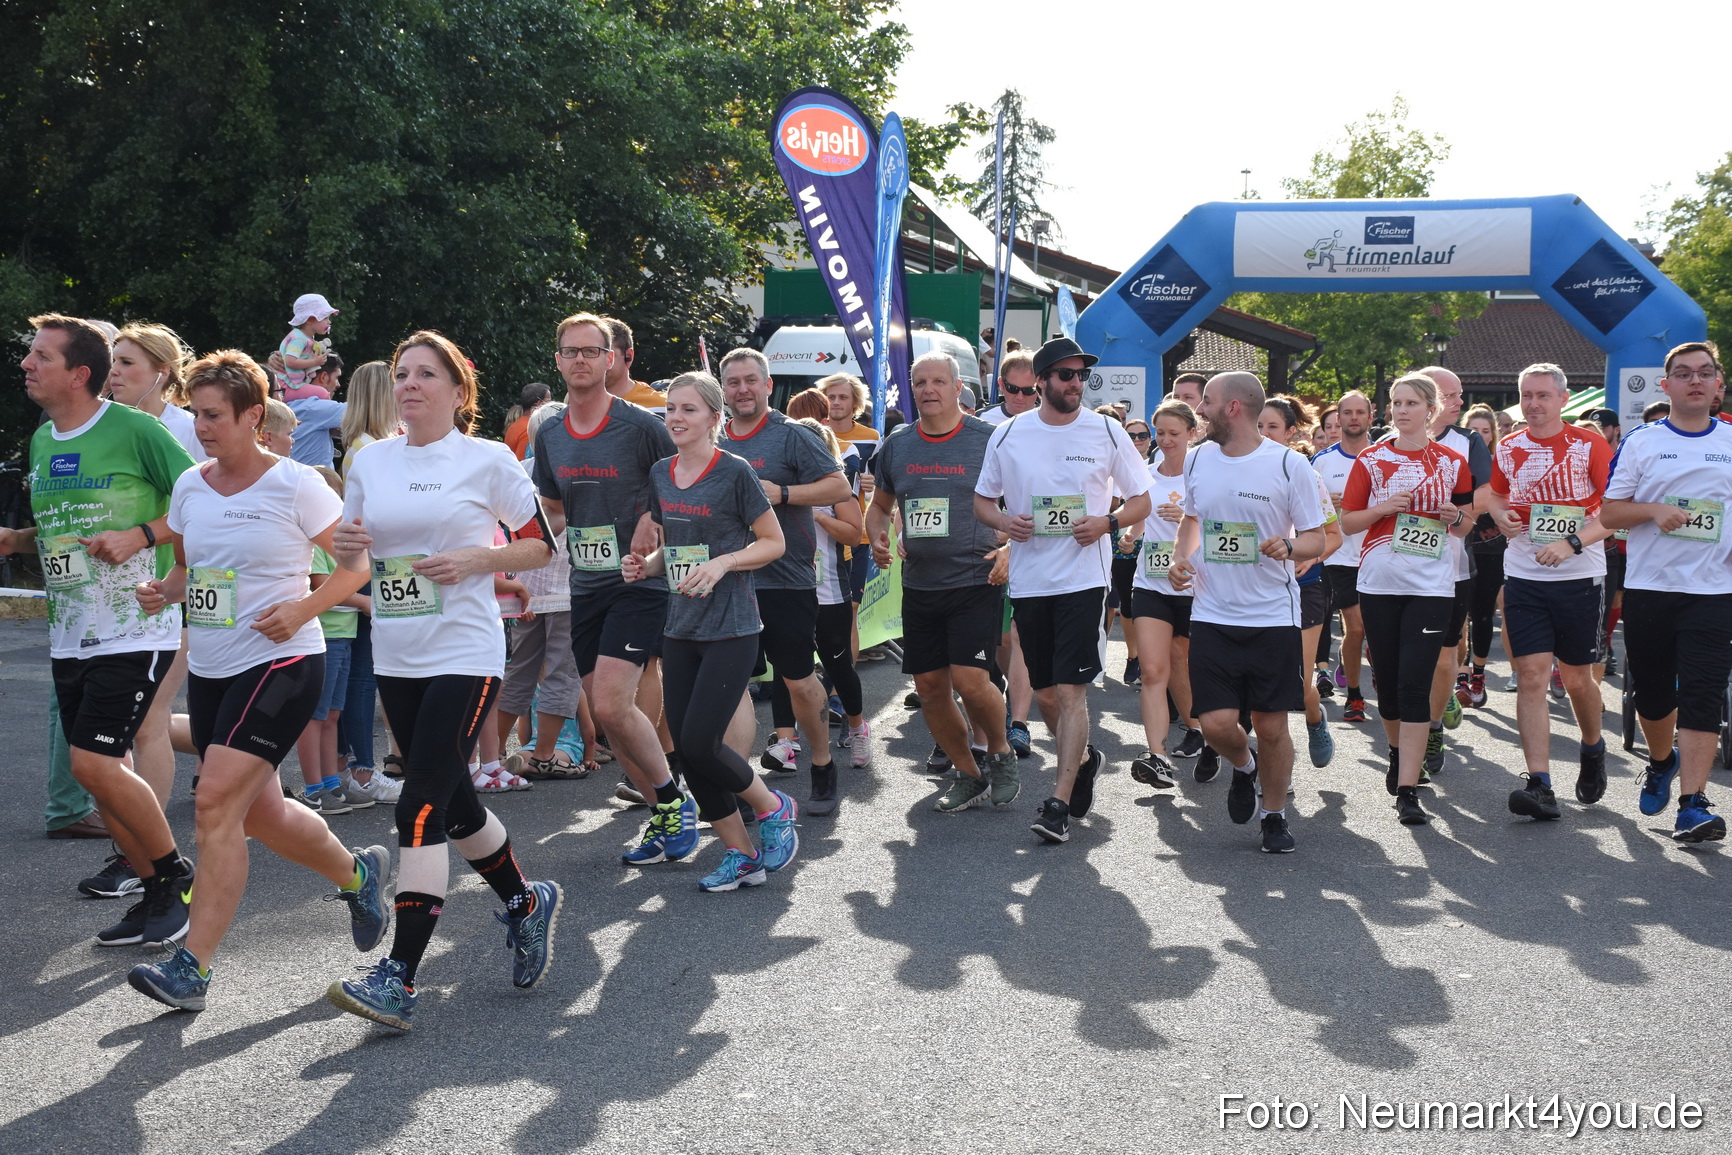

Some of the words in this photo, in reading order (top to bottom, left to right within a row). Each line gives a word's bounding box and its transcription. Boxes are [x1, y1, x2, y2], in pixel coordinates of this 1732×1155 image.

[1375, 227, 1411, 235] Fischer
[1346, 245, 1456, 264] firmenlauf
[1141, 284, 1197, 295] Fischer
[1573, 280, 1590, 289] und
[1592, 278, 1608, 286] das
[769, 352, 812, 361] abavent
[1066, 455, 1095, 464] auctores
[557, 465, 619, 479] Oberbank
[906, 463, 966, 475] Oberbank
[37, 473, 115, 490] firmenlauf
[409, 483, 442, 491] ANITA
[1238, 491, 1271, 502] auctores
[62, 501, 103, 512] Firmen
[39, 517, 65, 530] laufen
[70, 510, 112, 528] länger!
[224, 510, 260, 520] Andrea
[909, 512, 942, 527] 1775
[1048, 510, 1069, 525] 26
[1536, 518, 1576, 533] 2208
[1218, 536, 1239, 552] 25
[1399, 528, 1439, 548] 2226
[575, 542, 611, 558] 1776
[44, 554, 70, 576] 567
[1149, 554, 1172, 567] 133
[669, 563, 700, 580] 177
[380, 577, 420, 602] 654
[188, 587, 217, 611] 650
[94, 733, 115, 744] JAKO
[250, 735, 278, 749] macron
